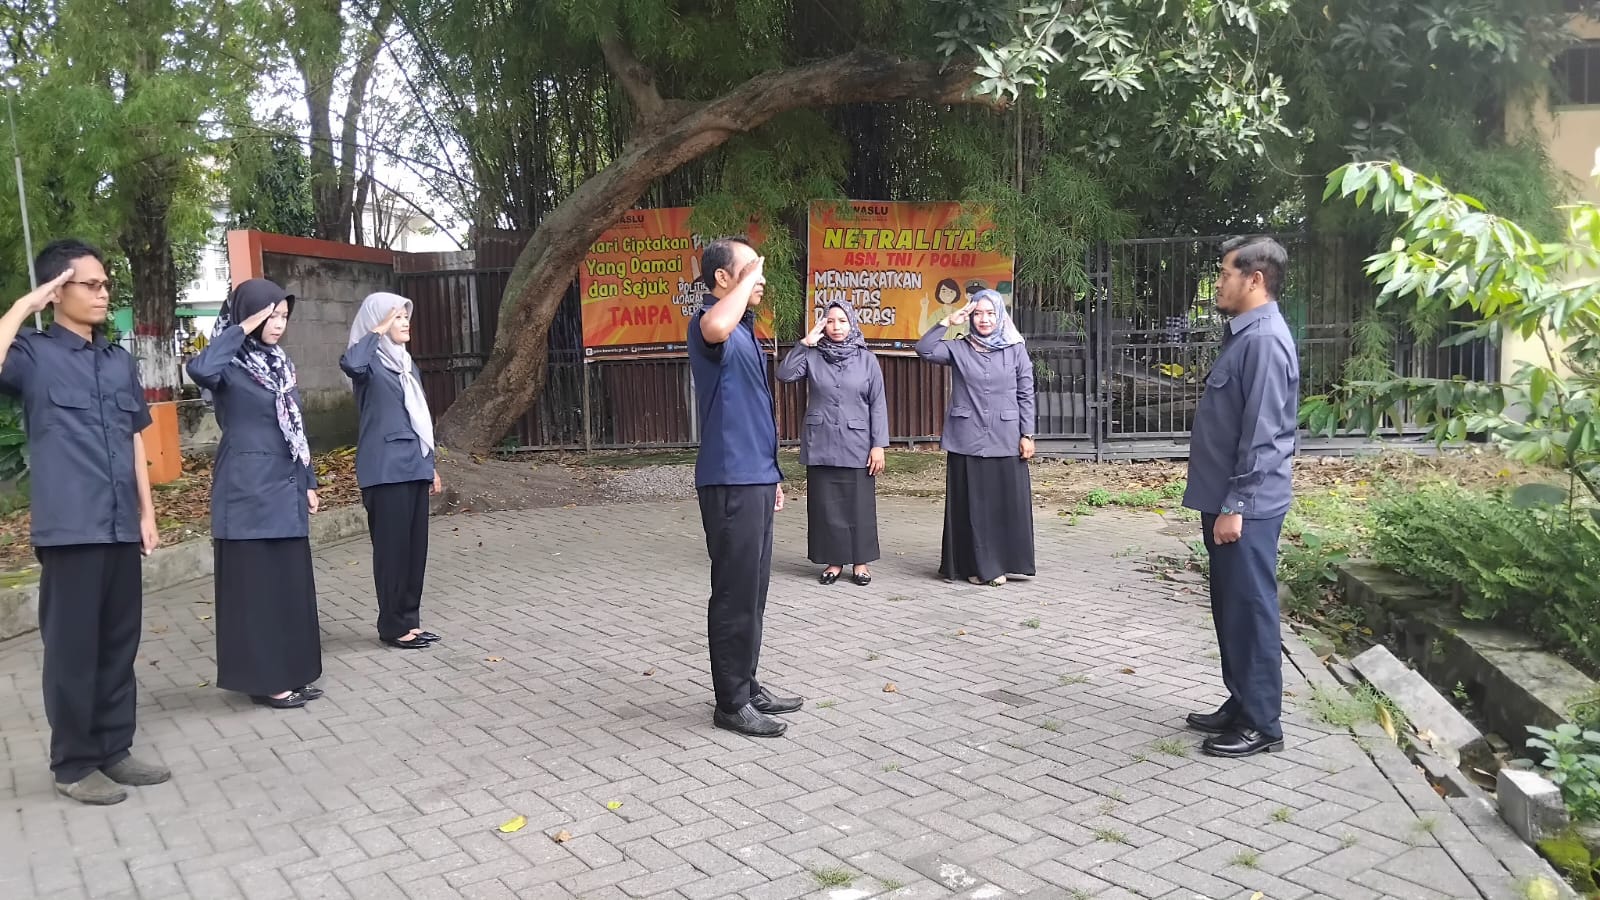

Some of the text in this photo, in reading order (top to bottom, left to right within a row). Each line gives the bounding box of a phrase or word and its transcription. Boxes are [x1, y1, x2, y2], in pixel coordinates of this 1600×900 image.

[622, 235, 688, 255] Ciptakan
[586, 256, 682, 278] Yang Damai
[844, 252, 976, 267] ASN, TNI / POLRI
[588, 277, 669, 298] dan Sejuk
[611, 307, 671, 326] TANPA
